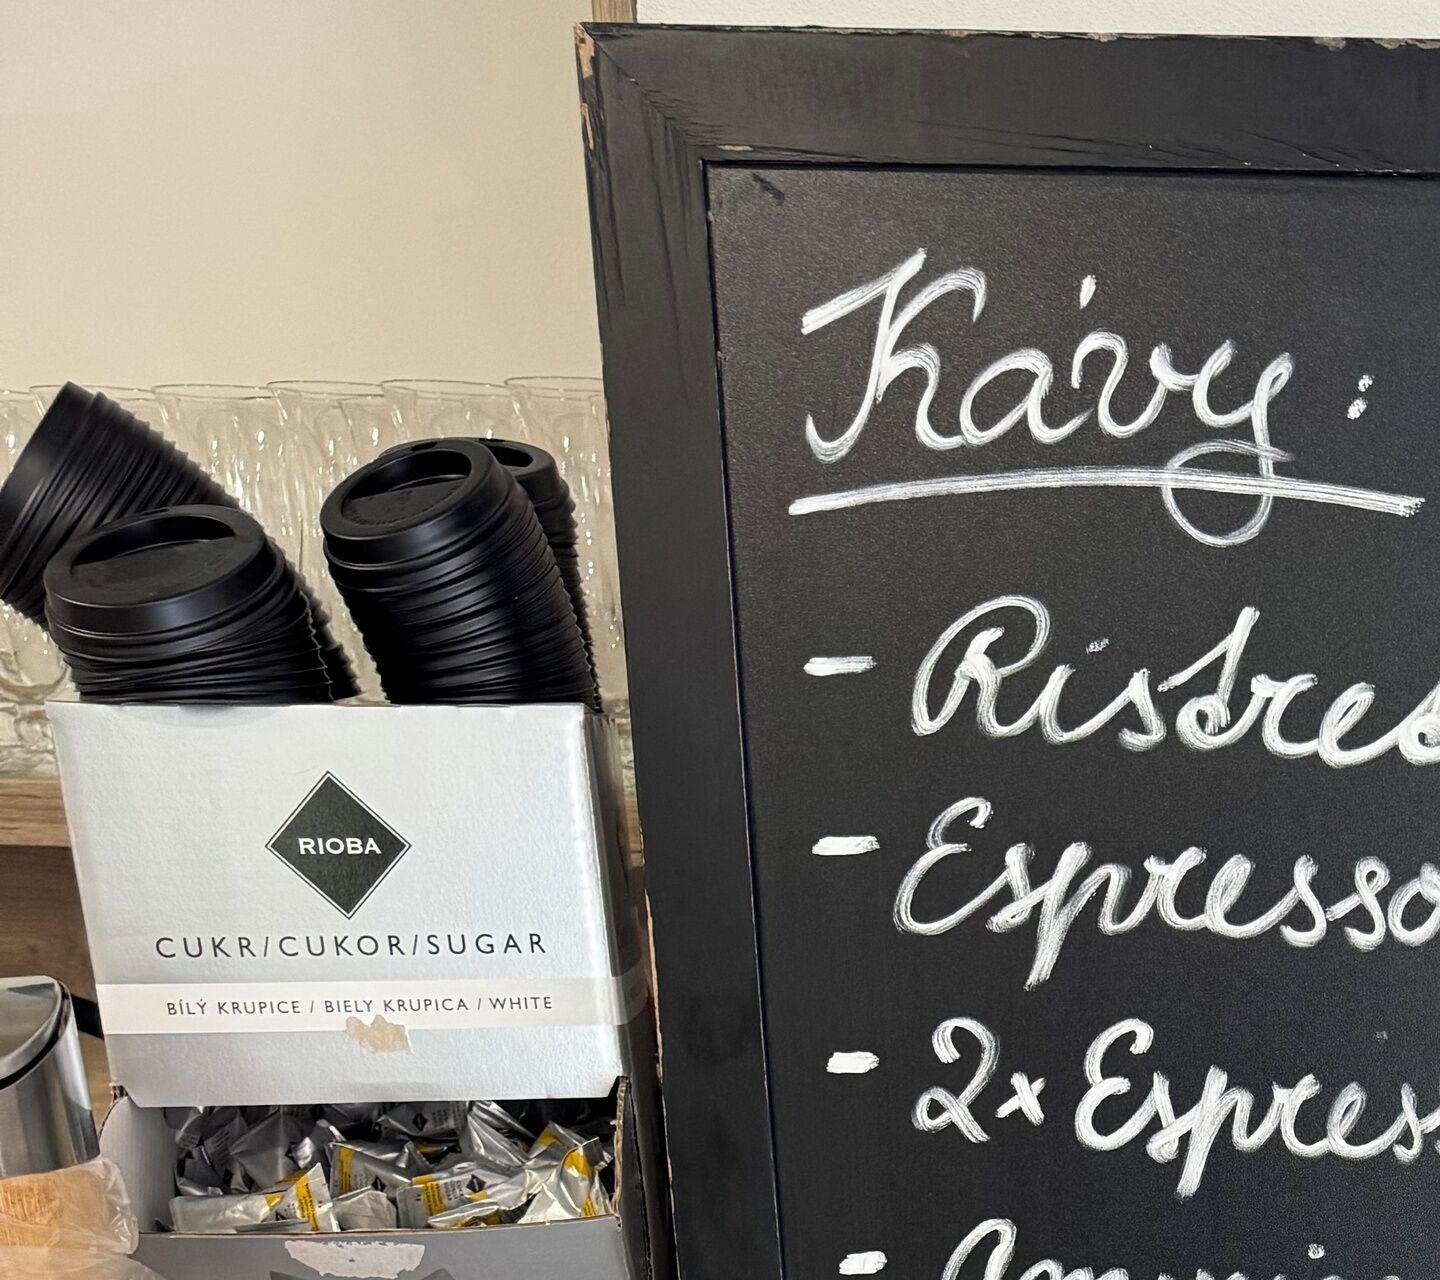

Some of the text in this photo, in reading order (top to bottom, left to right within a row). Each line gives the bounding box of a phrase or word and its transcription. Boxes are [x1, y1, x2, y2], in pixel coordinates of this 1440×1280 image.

[298, 837, 382, 855] RIOBA
[167, 998, 208, 1016] BÍLÝ
[217, 1000, 301, 1015] KRUPICE
[324, 999, 373, 1013] BIELY
[383, 998, 469, 1012] KRUPICA
[489, 996, 553, 1010] WHITE
[912, 1017, 1045, 1143] 2x
